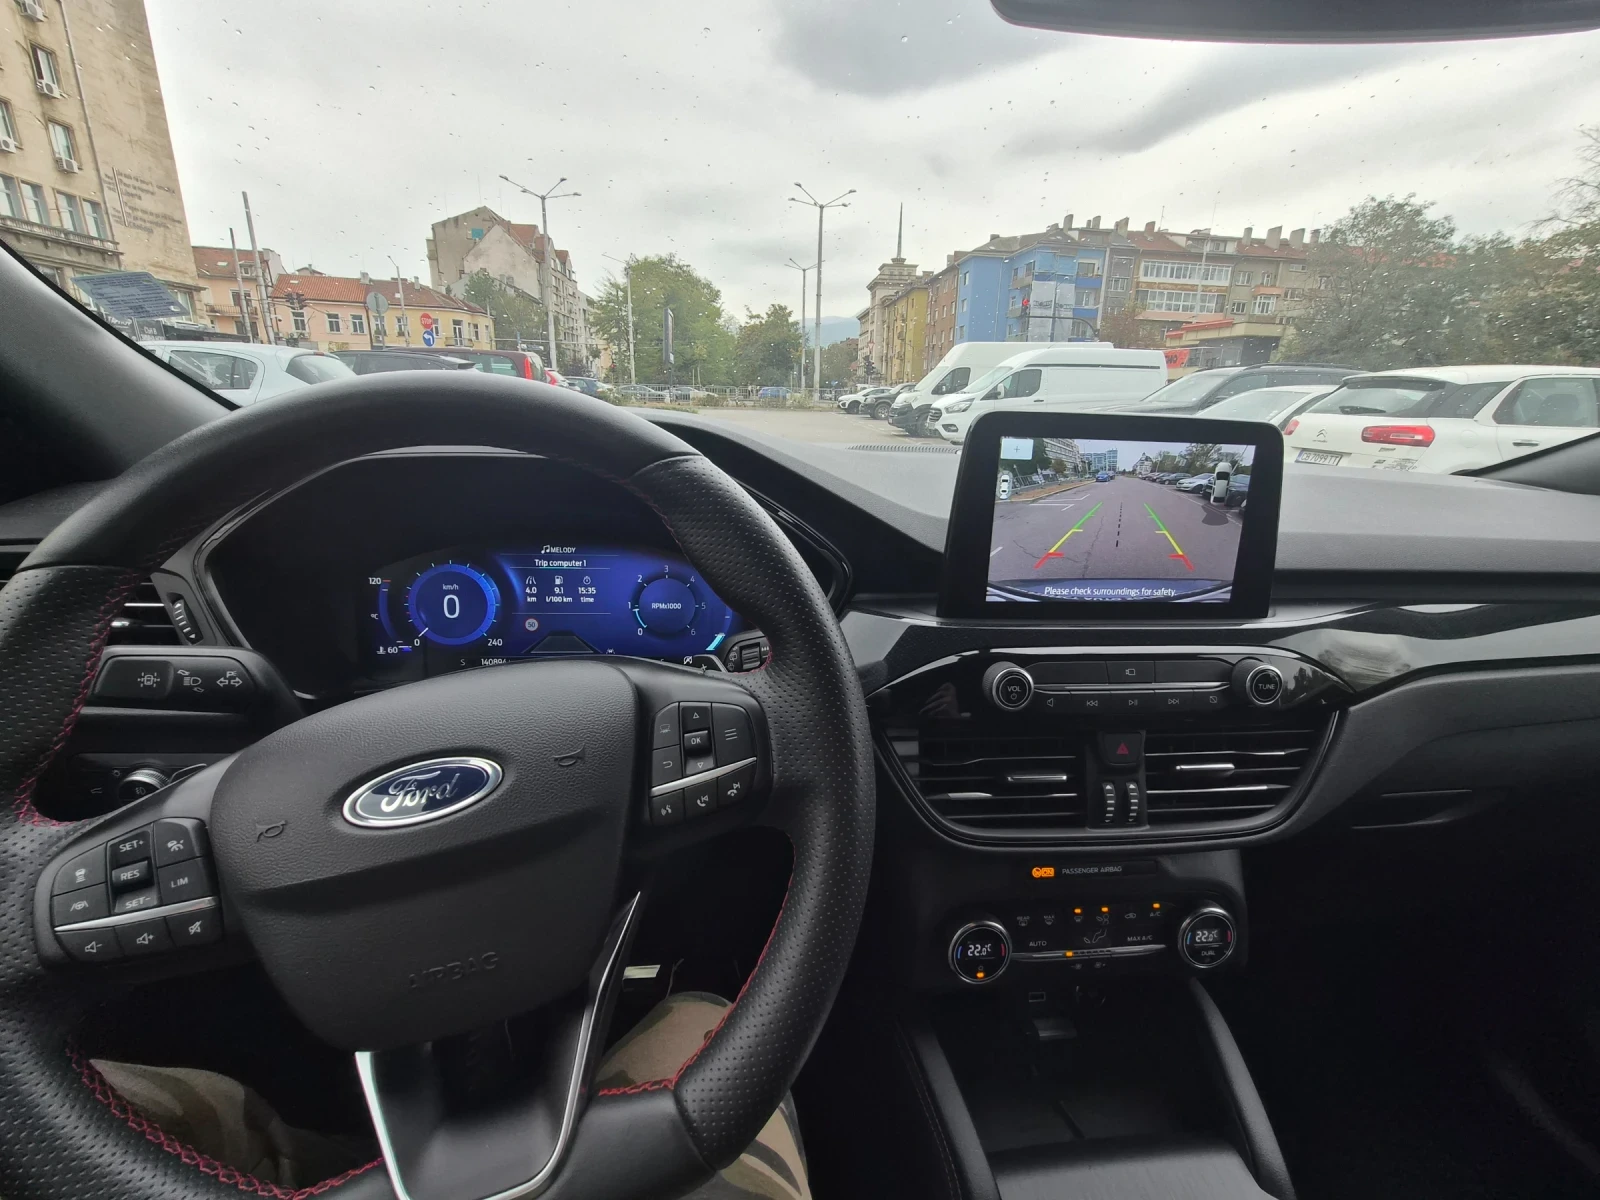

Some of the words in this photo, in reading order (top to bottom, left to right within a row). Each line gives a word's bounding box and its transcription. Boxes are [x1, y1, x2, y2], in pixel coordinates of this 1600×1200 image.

[421, 317, 432, 325] STOP
[550, 546, 576, 554] MELODY
[534, 559, 548, 568] Trip
[549, 560, 583, 568] computer
[664, 565, 669, 573] 3
[368, 577, 382, 585] 120
[637, 574, 643, 583] 2
[1044, 586, 1070, 595] Please
[1070, 587, 1092, 595] check
[1093, 587, 1140, 597] surroundings
[1141, 587, 1152, 596] for
[1152, 587, 1177, 597] safety.
[443, 594, 460, 619] 0
[651, 602, 682, 610] RPMx1000
[637, 628, 643, 636] 0
[690, 628, 696, 636] 6
[413, 639, 421, 647] 0
[487, 638, 503, 646] 240
[387, 646, 398, 654] 60
[1007, 685, 1022, 693] VOL
[690, 736, 702, 745] OK
[380, 770, 461, 813] Ford
[119, 839, 144, 853] SET+
[1062, 867, 1099, 875] PASSENGER
[1100, 865, 1123, 873] AIRBAG
[120, 869, 140, 881] RES
[170, 877, 189, 888] LIM
